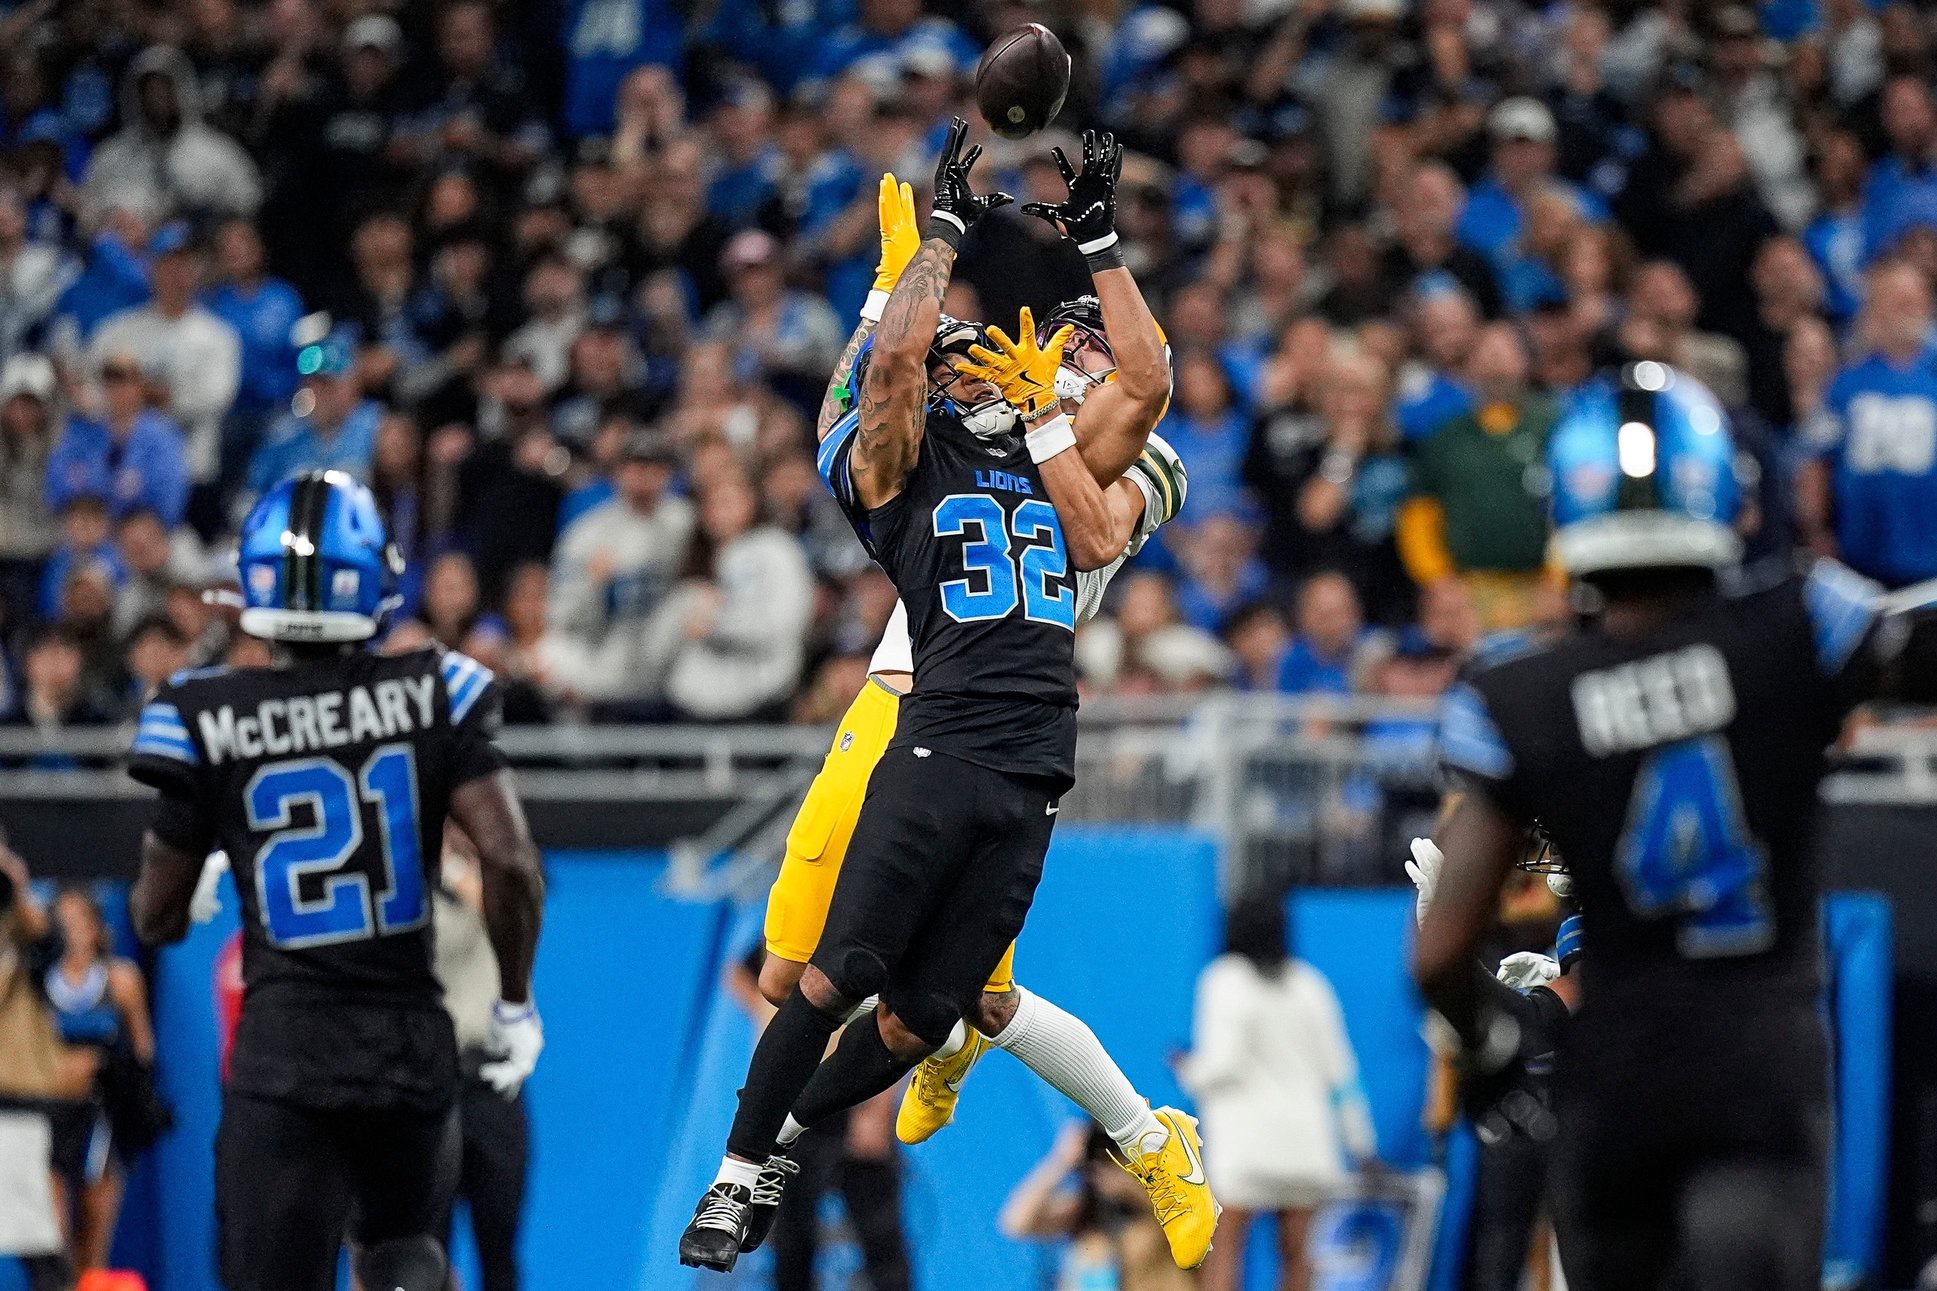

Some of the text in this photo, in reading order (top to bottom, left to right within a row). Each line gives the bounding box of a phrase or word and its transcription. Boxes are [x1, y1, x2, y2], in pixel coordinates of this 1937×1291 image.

[975, 469, 1033, 495] LIONS
[932, 493, 1075, 633] 32
[197, 674, 435, 766] McCREARY
[243, 741, 431, 949] 21
[1614, 732, 1776, 958] 4
